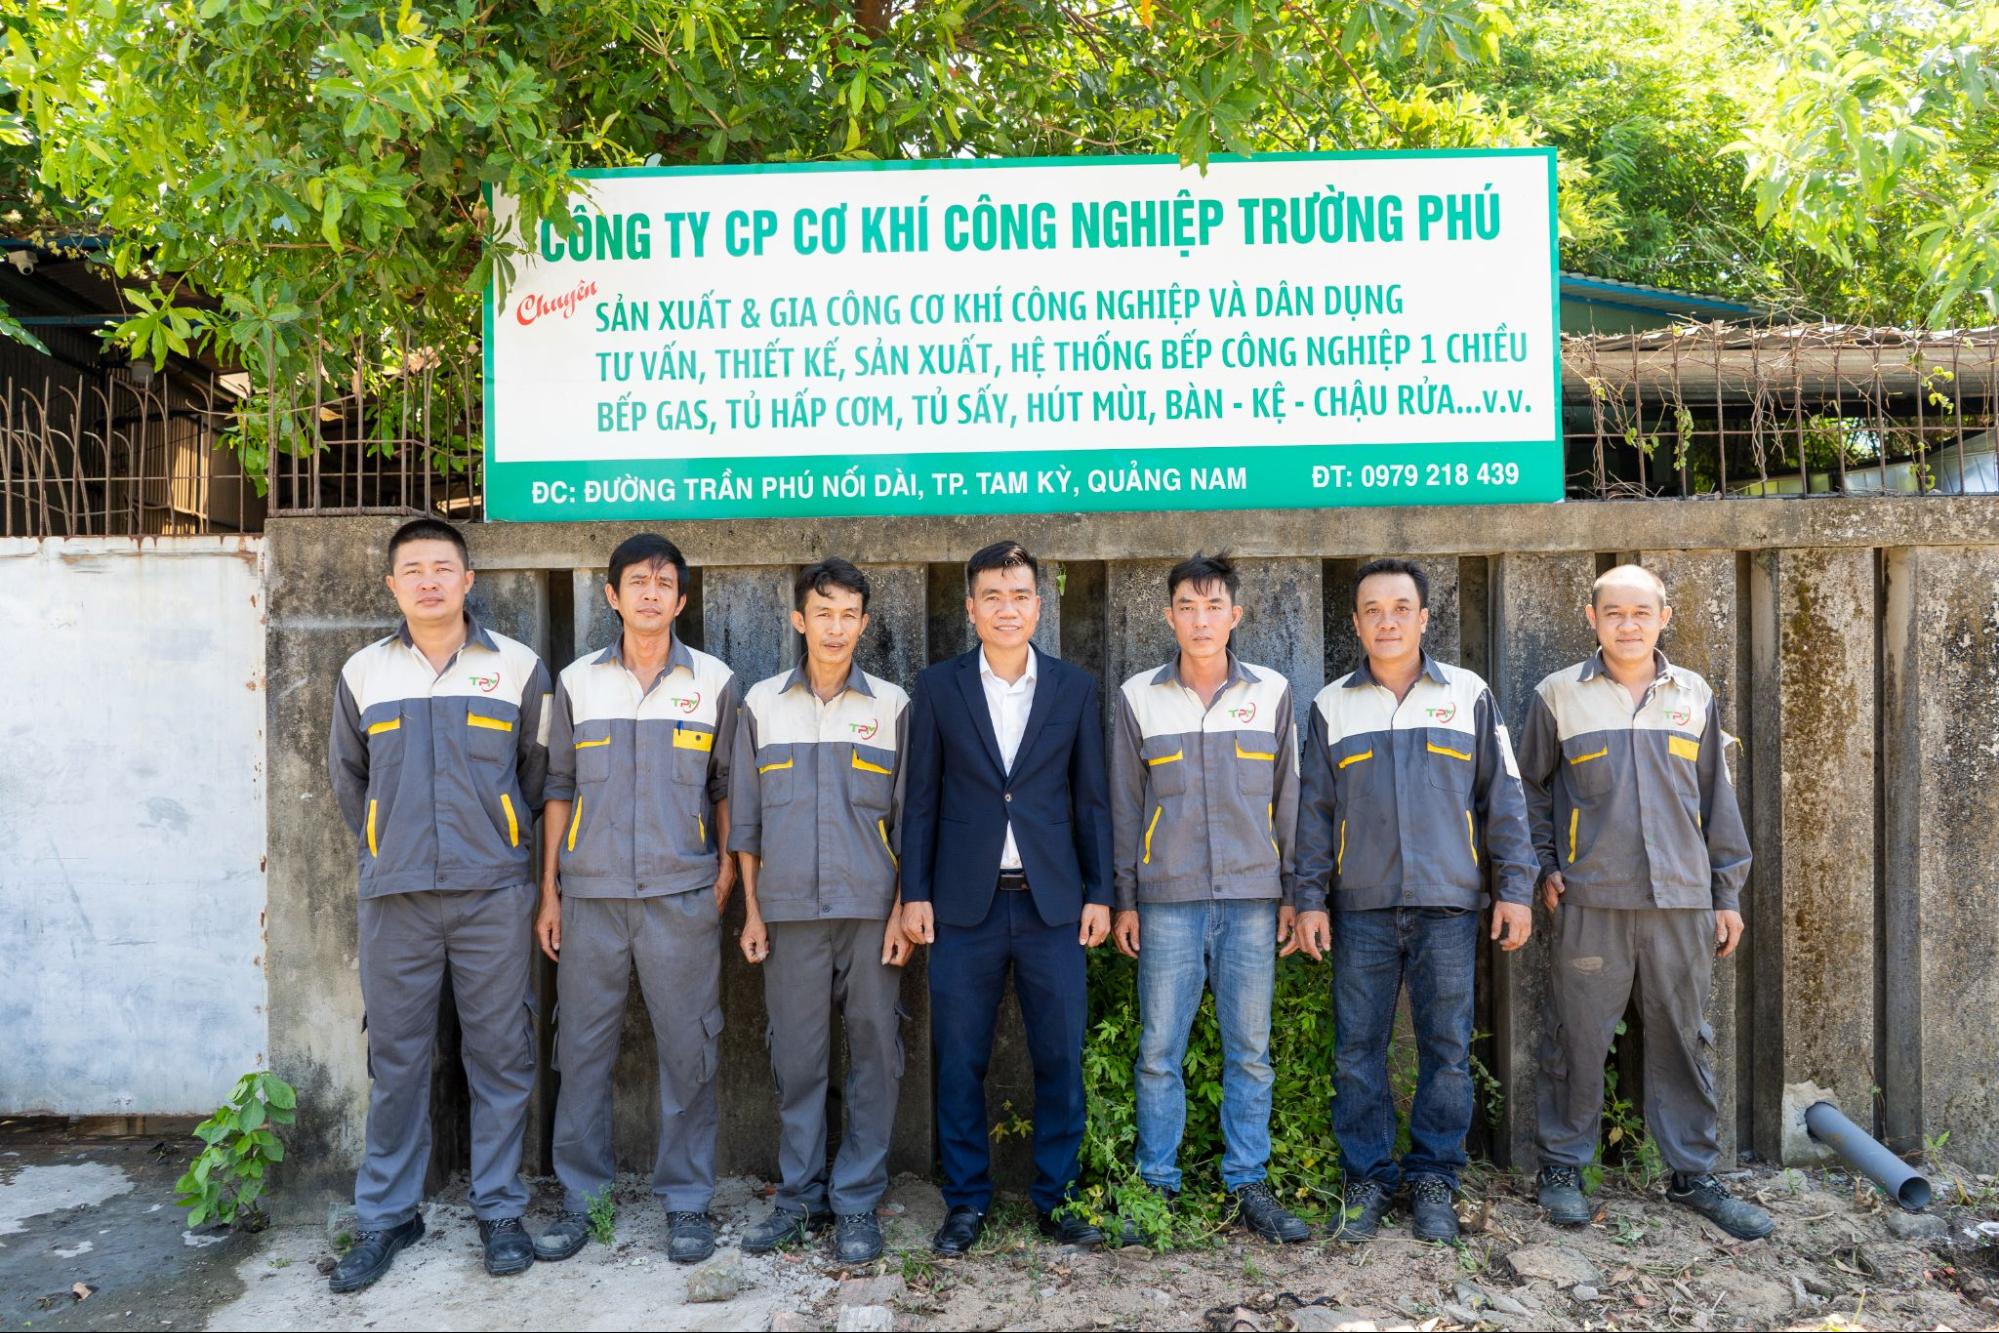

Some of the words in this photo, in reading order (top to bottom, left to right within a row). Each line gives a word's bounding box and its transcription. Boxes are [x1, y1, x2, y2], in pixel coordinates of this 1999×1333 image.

[540, 204, 651, 263] CÔNG
[664, 211, 711, 258] TY
[725, 209, 778, 257] CP
[793, 202, 848, 256] CƠ
[861, 195, 929, 254] KHÍ
[944, 193, 1056, 252] CÔNG
[1071, 188, 1224, 258] NGHIỆP
[1237, 184, 1403, 245] TRƯỜNG
[1418, 183, 1500, 241] PHÚ
[516, 279, 598, 326] Chuyên
[596, 293, 649, 333] SẢN
[658, 289, 731, 330] XUẤT
[741, 298, 760, 328] &
[770, 297, 818, 328] GIA
[826, 289, 901, 326] CÔNG
[910, 294, 945, 325] CƠ
[954, 285, 1003, 323] KHÍ
[1012, 285, 1086, 323] CÔNG
[1096, 282, 1200, 326] NGHIỆP
[1209, 280, 1247, 318] VÀ
[1256, 280, 1314, 317] DÂN
[1324, 284, 1403, 322] DỤNG
[595, 352, 634, 382] TƯ
[640, 340, 706, 384] VẤN,
[714, 337, 795, 379] THIẾT
[804, 336, 845, 382] KẾ,
[855, 337, 909, 376] SẢN
[918, 333, 1001, 378] XUẤT,
[1011, 336, 1045, 379] HỆ
[1053, 330, 1152, 372] THỐNG
[1161, 329, 1212, 369] BẾP
[1221, 331, 1297, 368] CÔNG
[1306, 328, 1411, 371] NGHIỆP
[1421, 334, 1437, 364] 1
[1446, 322, 1527, 364] CHIỀU
[597, 394, 647, 432] BẾP
[656, 399, 717, 435] GAS,
[725, 390, 761, 429] TỦ
[771, 387, 826, 428] HẤP
[836, 396, 902, 431] CƠM,
[912, 386, 947, 425] TỦ
[957, 384, 1017, 428] SẤY,
[1027, 385, 1083, 423] HÚT
[1092, 383, 1156, 426] MÙI,
[1165, 382, 1223, 420] BÀN
[1252, 380, 1286, 424] KỆ
[1313, 379, 1387, 423] CHẬU
[532, 481, 575, 504] ĐC:
[584, 473, 675, 502] ĐƯỜNG
[684, 469, 752, 500] TRẦN
[762, 470, 813, 498] PHÚ
[823, 465, 865, 497] NỐI
[875, 468, 923, 499] DÀI,
[932, 473, 967, 495] TP.
[976, 471, 1027, 494] TAM
[1038, 465, 1079, 496] KỲ,
[1088, 460, 1180, 492] QUẢNG
[1191, 468, 1246, 490] NAM
[1312, 465, 1351, 487] ĐT:
[1362, 465, 1418, 487] 0979
[1426, 464, 1468, 485] 218
[1477, 463, 1519, 485] 439
